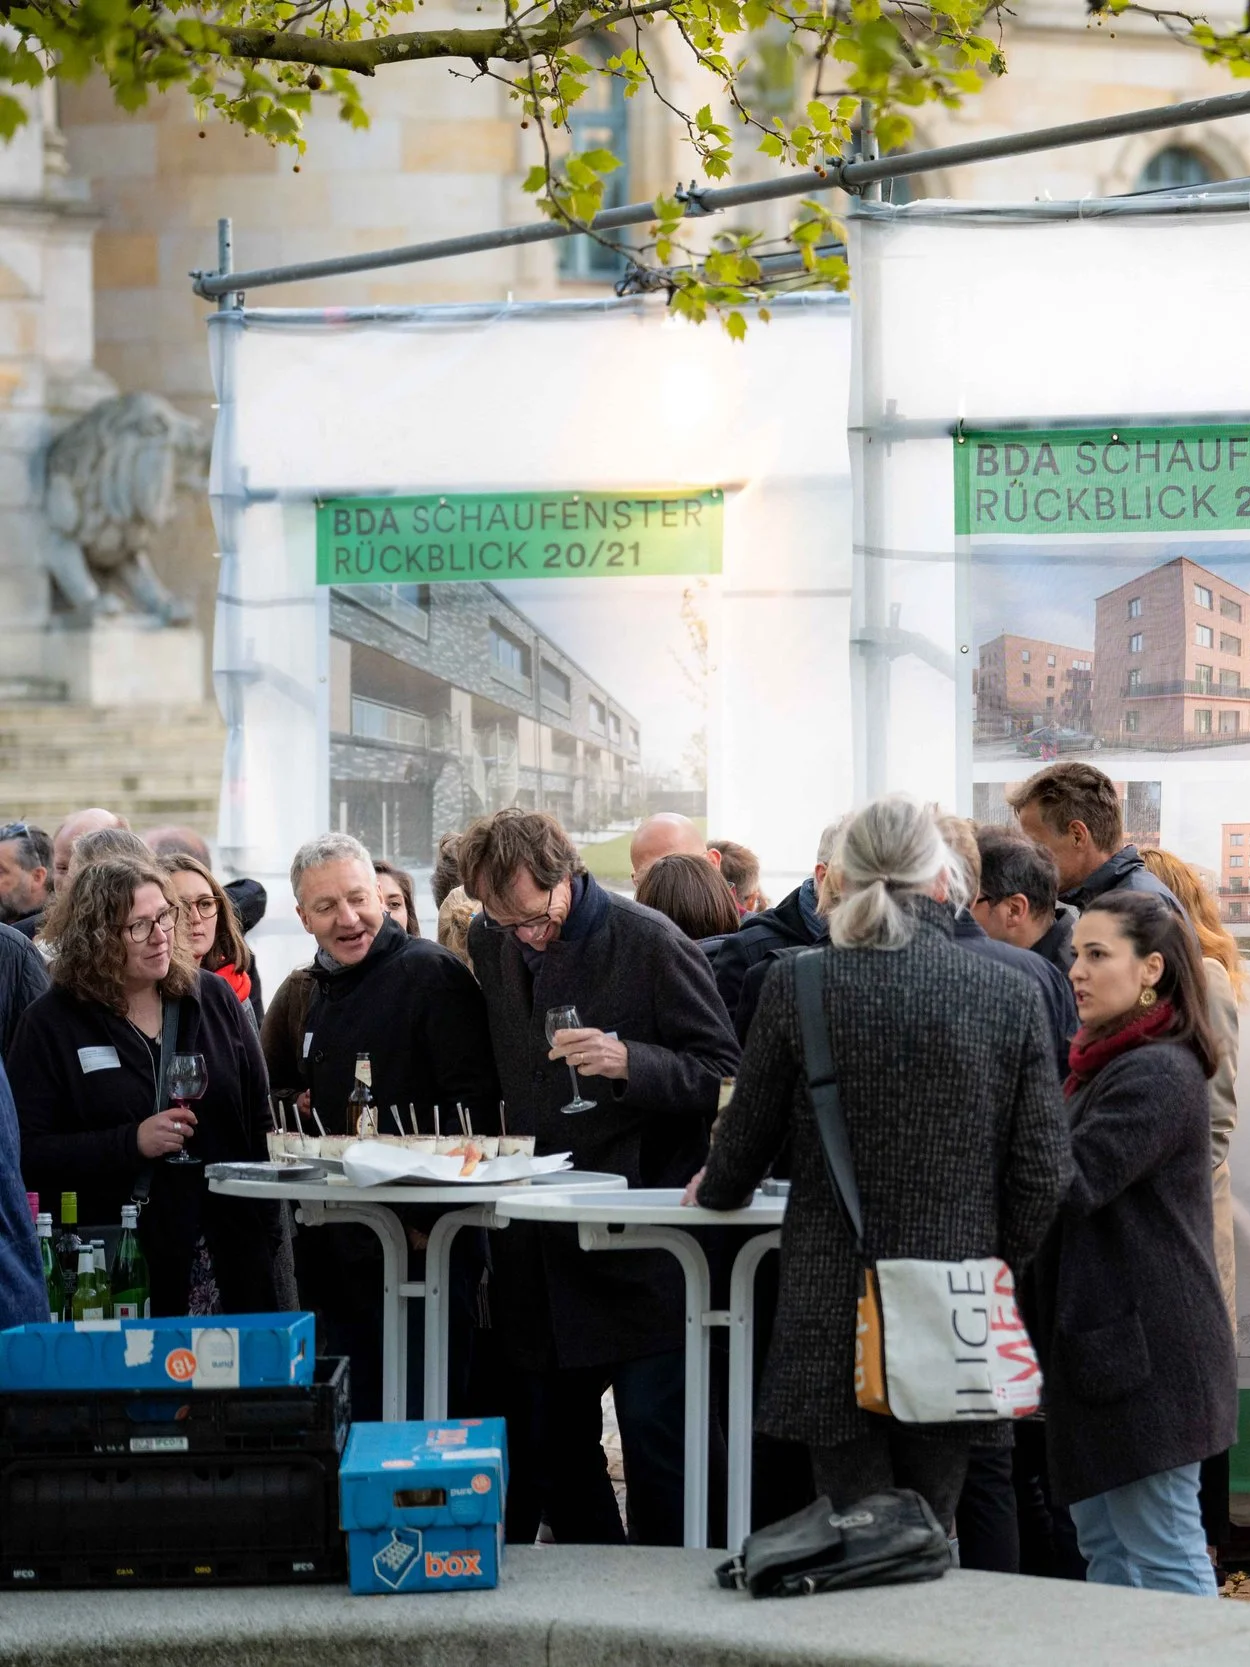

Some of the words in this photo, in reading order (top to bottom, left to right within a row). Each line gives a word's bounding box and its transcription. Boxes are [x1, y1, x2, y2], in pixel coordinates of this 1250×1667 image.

[976, 441, 1060, 477] BDA
[333, 507, 400, 536] BDA
[412, 499, 702, 534] SCHAUFENSTER
[976, 481, 1217, 523] RÜCKBLICK
[334, 541, 528, 575] RÜCKBLICK
[542, 541, 641, 569] 20/21
[425, 1551, 482, 1578] box
